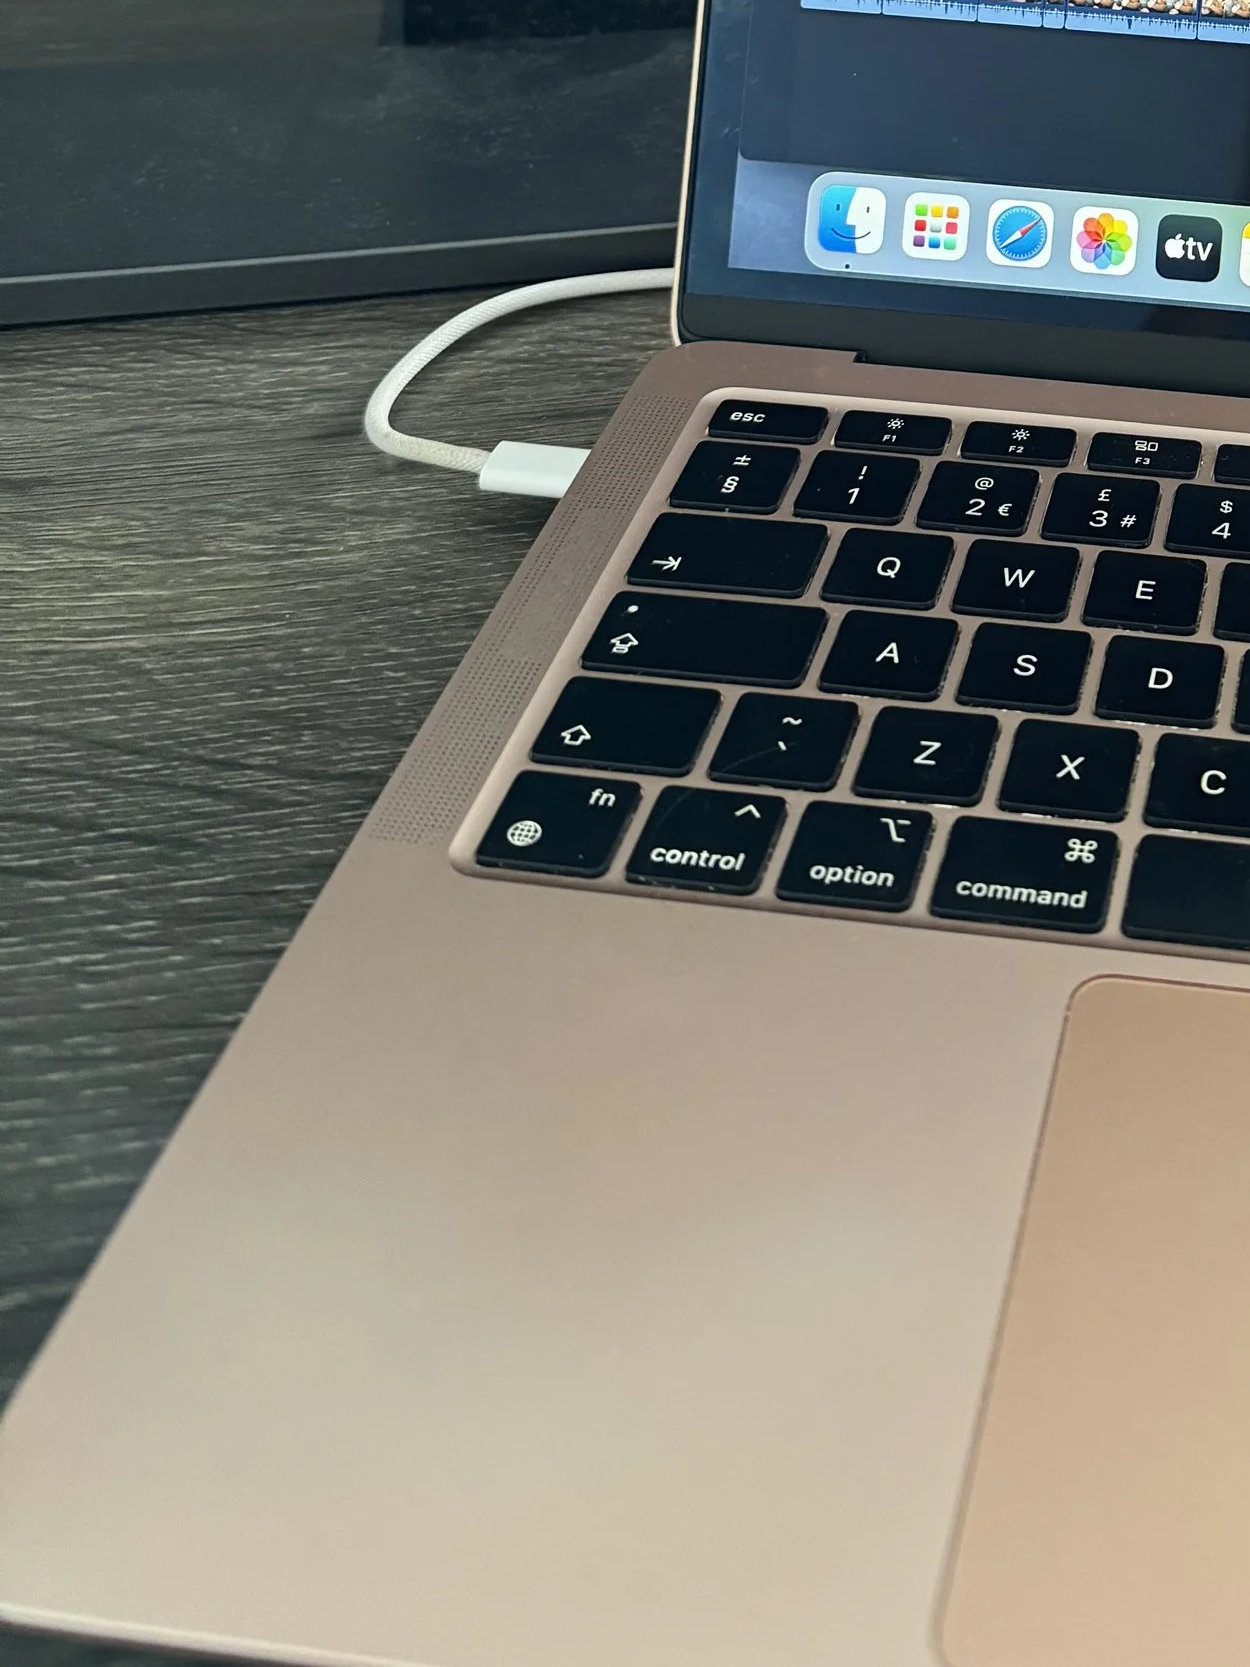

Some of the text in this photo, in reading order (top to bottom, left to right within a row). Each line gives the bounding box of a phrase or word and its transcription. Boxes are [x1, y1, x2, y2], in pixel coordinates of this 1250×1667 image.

[1186, 242, 1213, 262] tv
[730, 410, 766, 424] esc
[883, 434, 898, 444] F1
[1008, 444, 1024, 455] F2
[1135, 456, 1150, 466] F3
[847, 486, 860, 506] 1
[965, 497, 985, 517] 2
[1089, 510, 1109, 529] 3
[1212, 522, 1231, 540] 4
[876, 556, 900, 580] Q
[1003, 568, 1035, 588] W
[1135, 580, 1157, 601] E
[875, 642, 900, 665] A
[1013, 654, 1038, 677] S
[1148, 668, 1173, 691] D
[914, 741, 941, 766] Z
[1056, 754, 1085, 780] X
[1200, 770, 1228, 795] C
[588, 788, 616, 807] fn
[650, 844, 745, 871] control
[809, 861, 895, 889] option
[956, 878, 1087, 909] command
